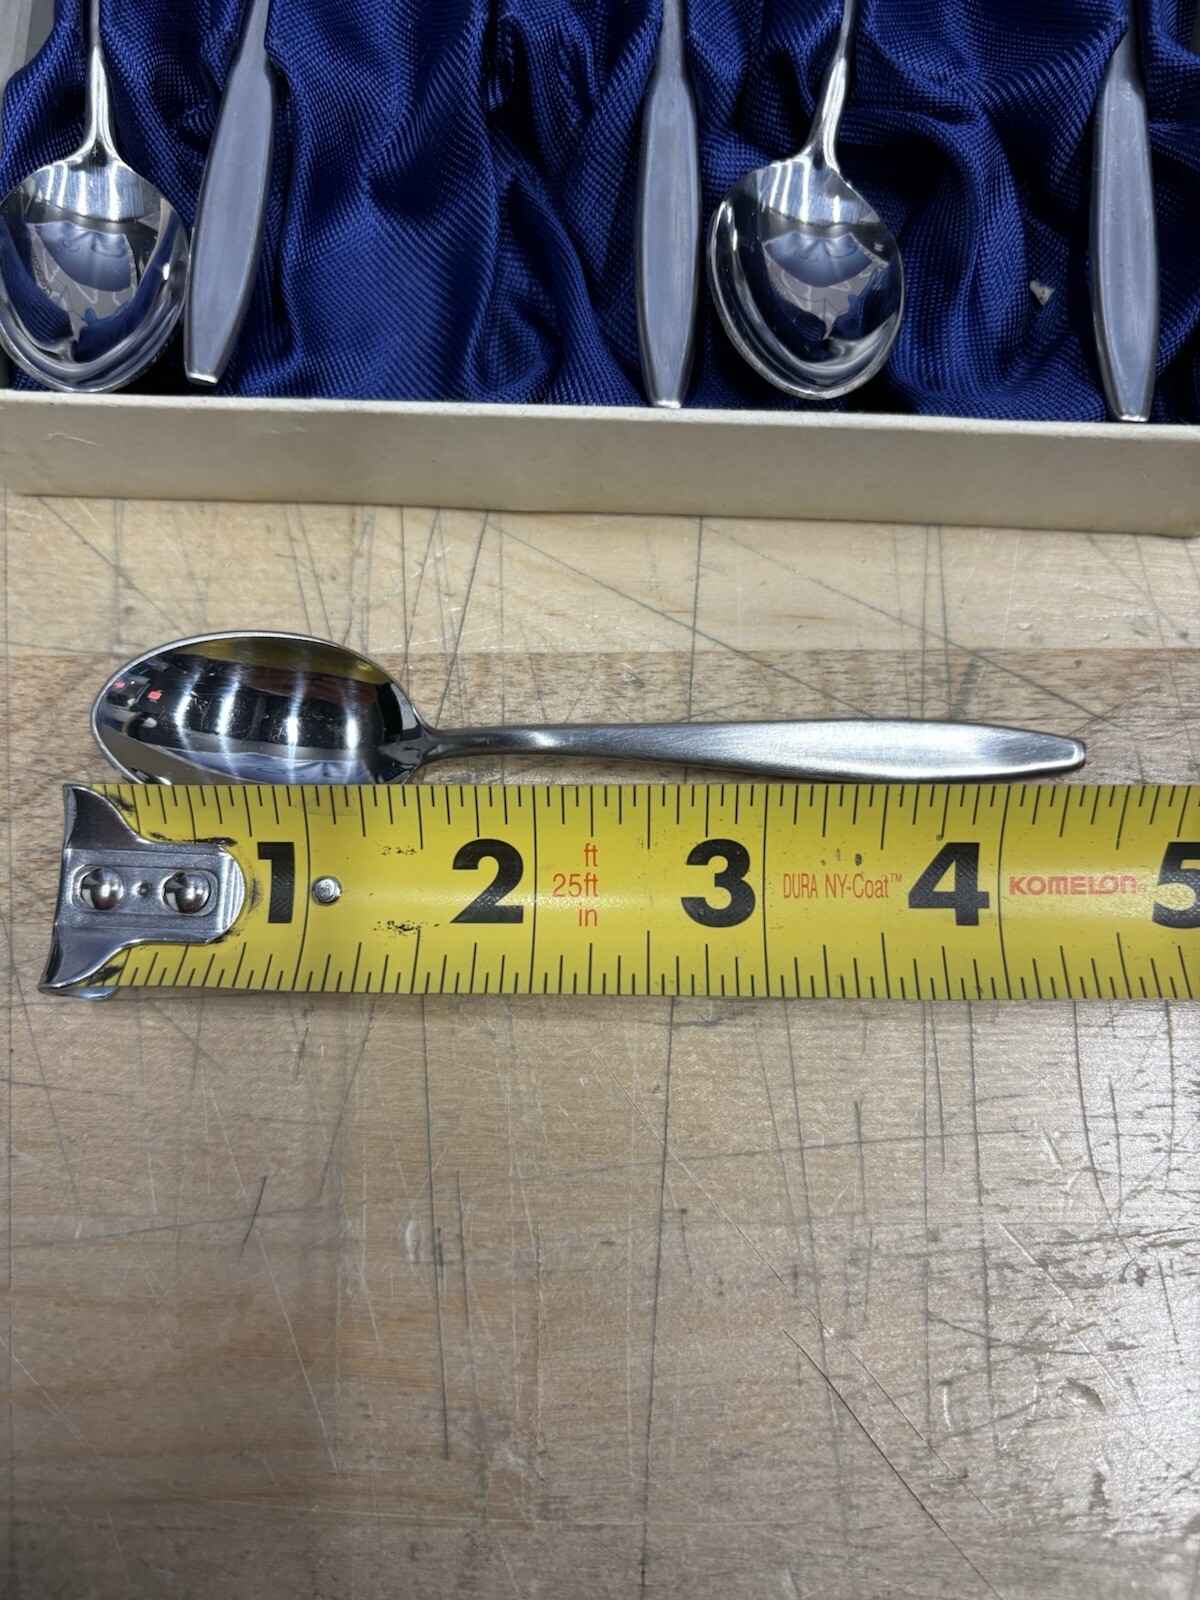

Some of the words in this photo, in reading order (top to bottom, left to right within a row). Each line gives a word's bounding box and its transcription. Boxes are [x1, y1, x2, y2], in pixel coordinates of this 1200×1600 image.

[256, 841, 296, 924] 1
[450, 838, 524, 924] 2
[552, 871, 599, 898] 25ft
[583, 842, 599, 868] ft
[680, 838, 756, 928] 3
[782, 872, 819, 899] DURA
[908, 841, 990, 926] 4
[1151, 841, 1200, 929] 5
[578, 902, 598, 928] in
